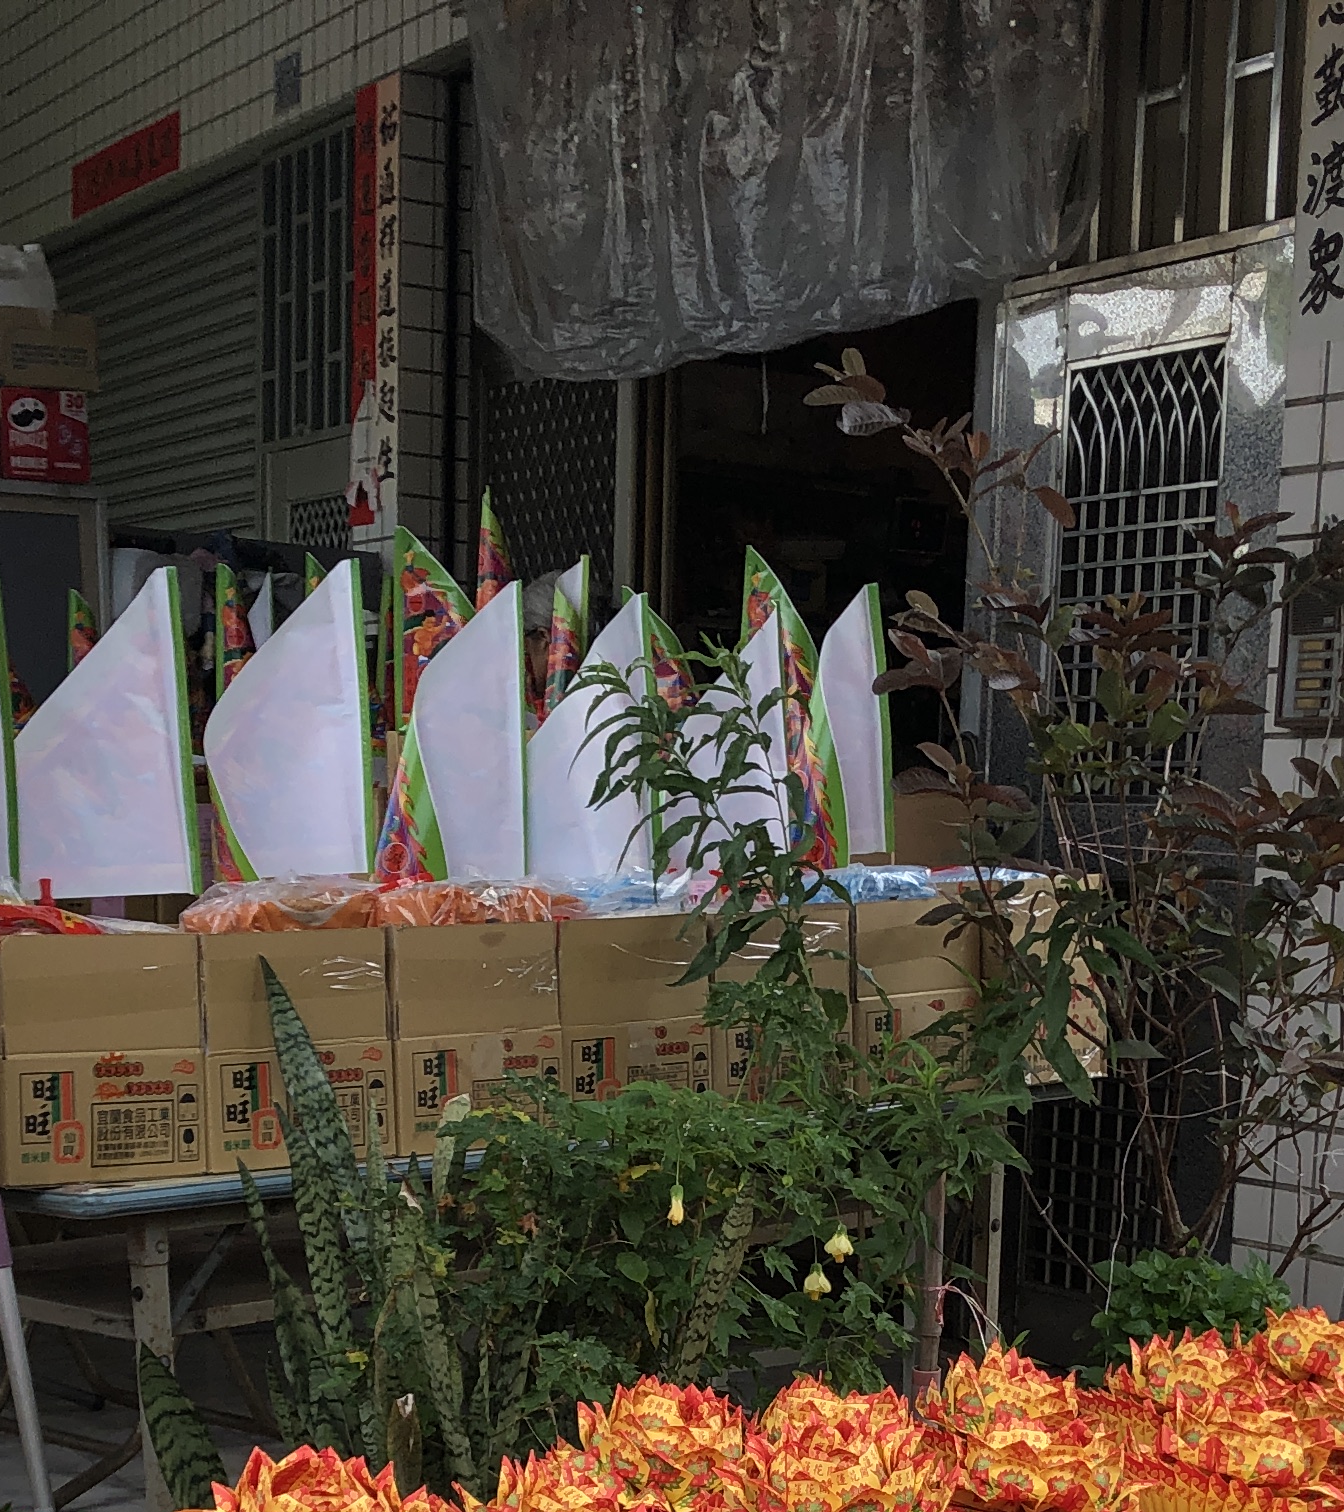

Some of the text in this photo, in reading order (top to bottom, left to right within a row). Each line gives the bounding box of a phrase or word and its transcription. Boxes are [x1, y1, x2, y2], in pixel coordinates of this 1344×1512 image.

[226, 1065, 256, 1124] 旺旺
[417, 1052, 445, 1110] 旺旺
[575, 1041, 601, 1094] 旺旺
[24, 1073, 60, 1136] 旺旺
